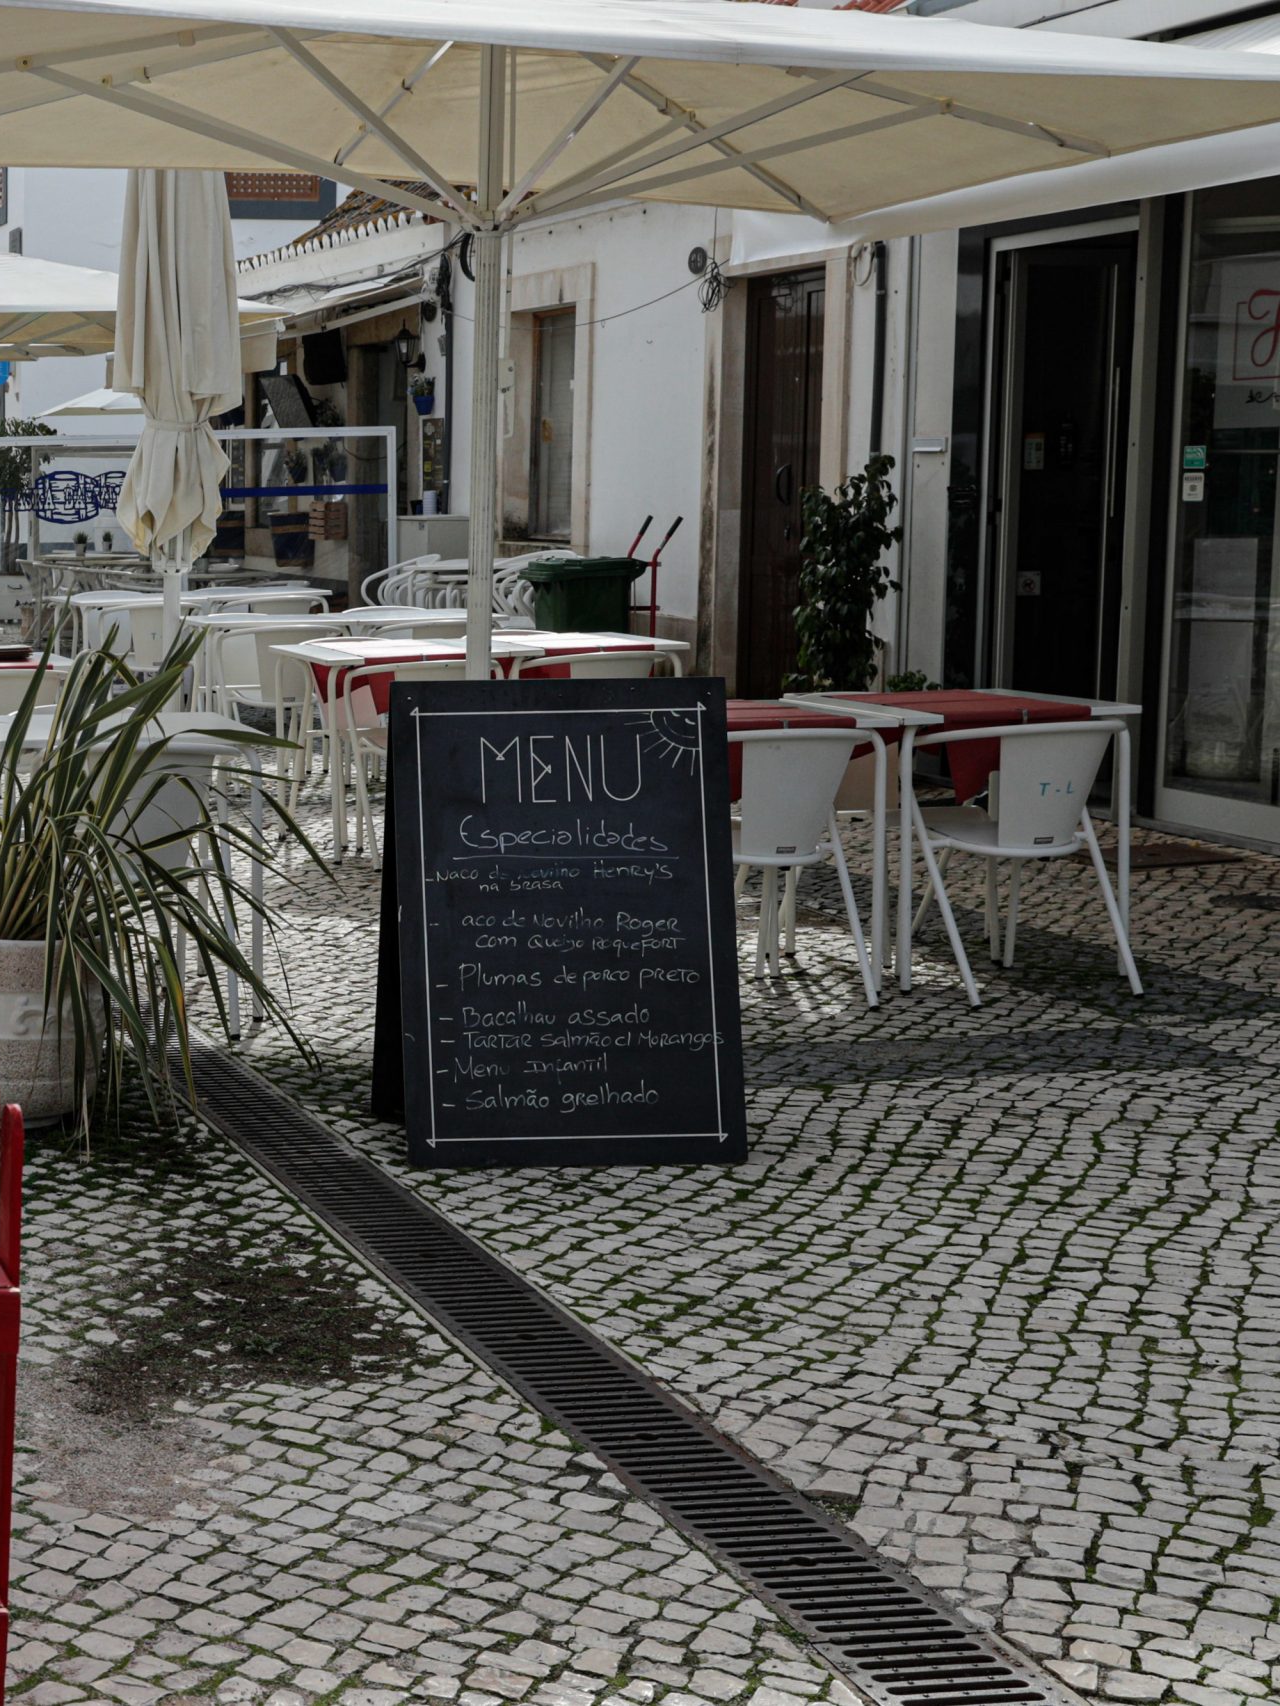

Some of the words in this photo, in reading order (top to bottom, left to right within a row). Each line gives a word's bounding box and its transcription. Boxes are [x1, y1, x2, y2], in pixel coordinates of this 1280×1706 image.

[480, 734, 642, 804] MENU
[459, 815, 669, 854] Especialidades
[479, 881, 500, 893] na
[502, 909, 526, 928] de
[533, 907, 605, 929] Novilho
[458, 963, 542, 992] Plumas
[553, 965, 577, 985] de
[462, 1001, 556, 1028] Bacalhau
[568, 1003, 650, 1027] assado
[454, 1056, 511, 1084] Menu
[465, 1084, 550, 1110] Salmão
[561, 1079, 659, 1113] grelhado
